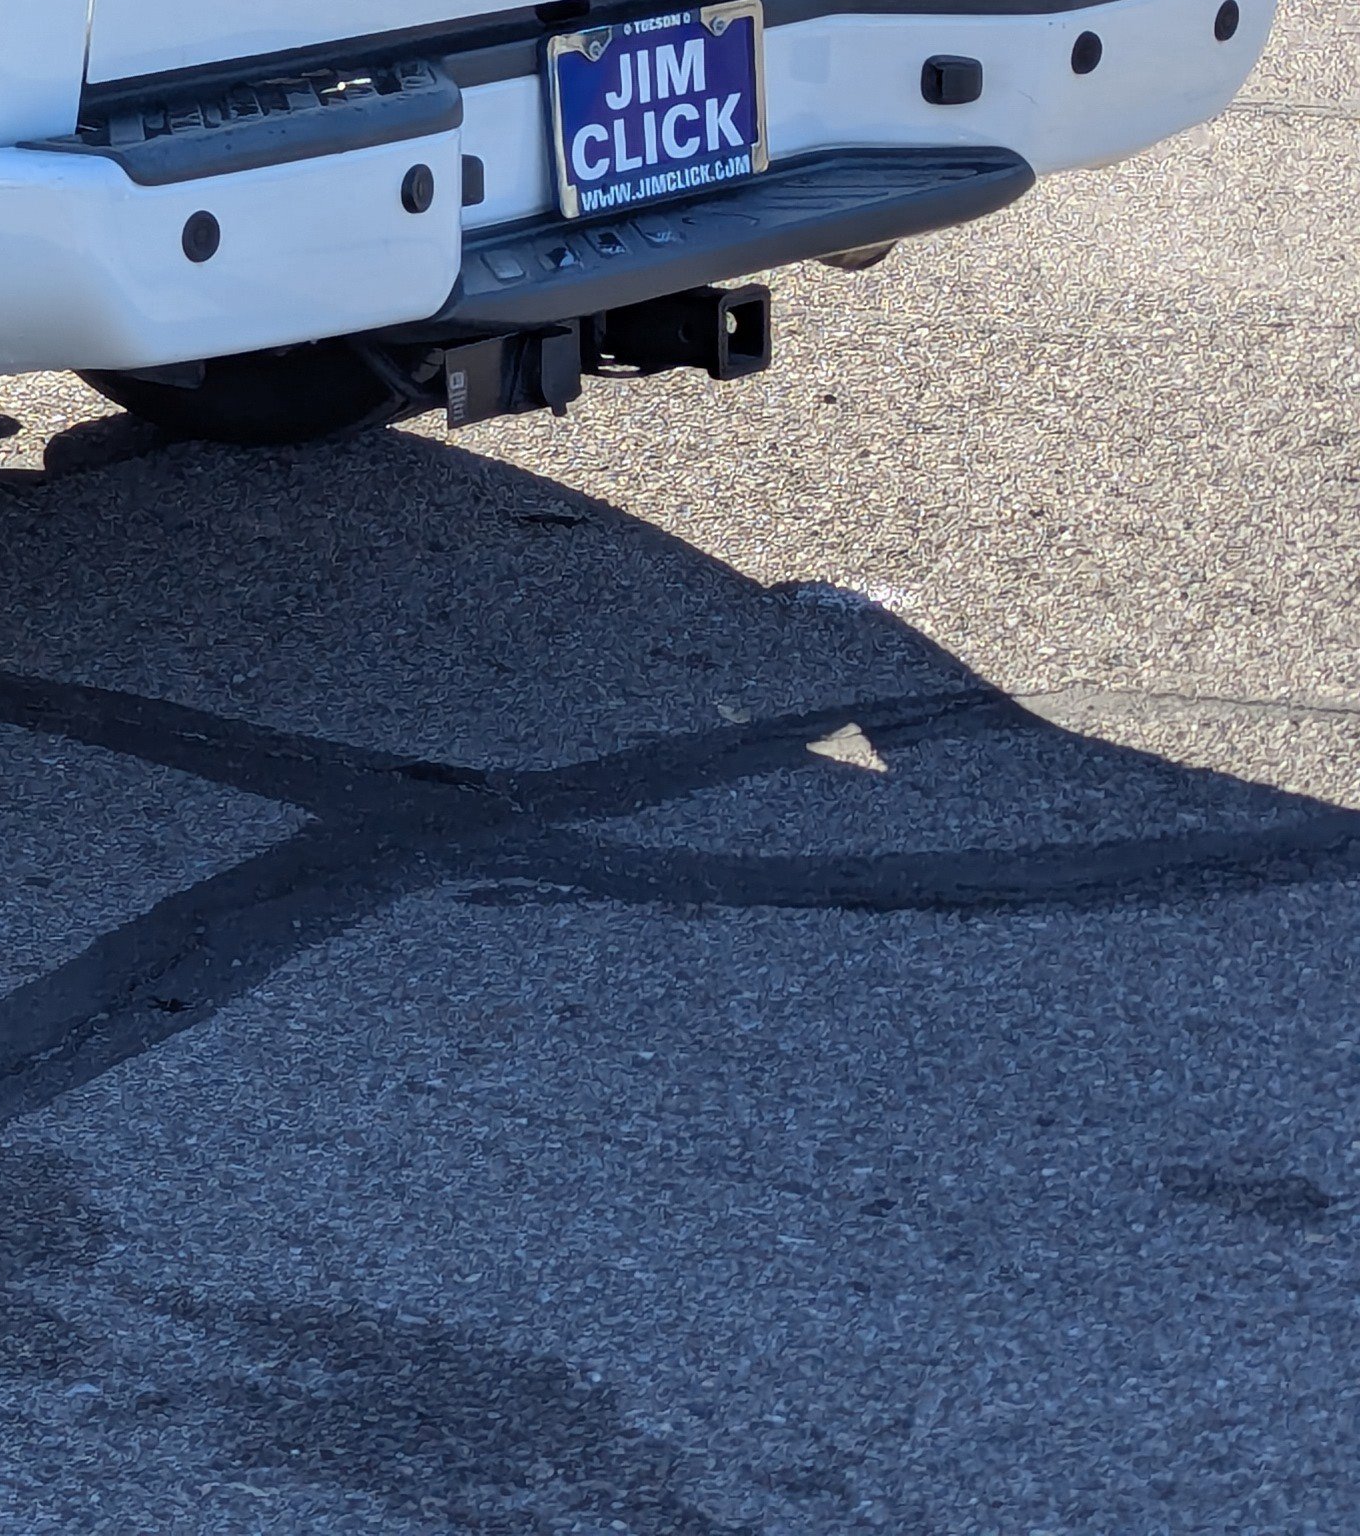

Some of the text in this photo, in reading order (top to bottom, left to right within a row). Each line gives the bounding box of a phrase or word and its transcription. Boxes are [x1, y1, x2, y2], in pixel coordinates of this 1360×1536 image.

[633, 12, 681, 35] TUCSON
[605, 37, 706, 111] JIM
[571, 92, 744, 181] CLICK
[580, 154, 751, 212] WWW.JIMCLICK.COM
